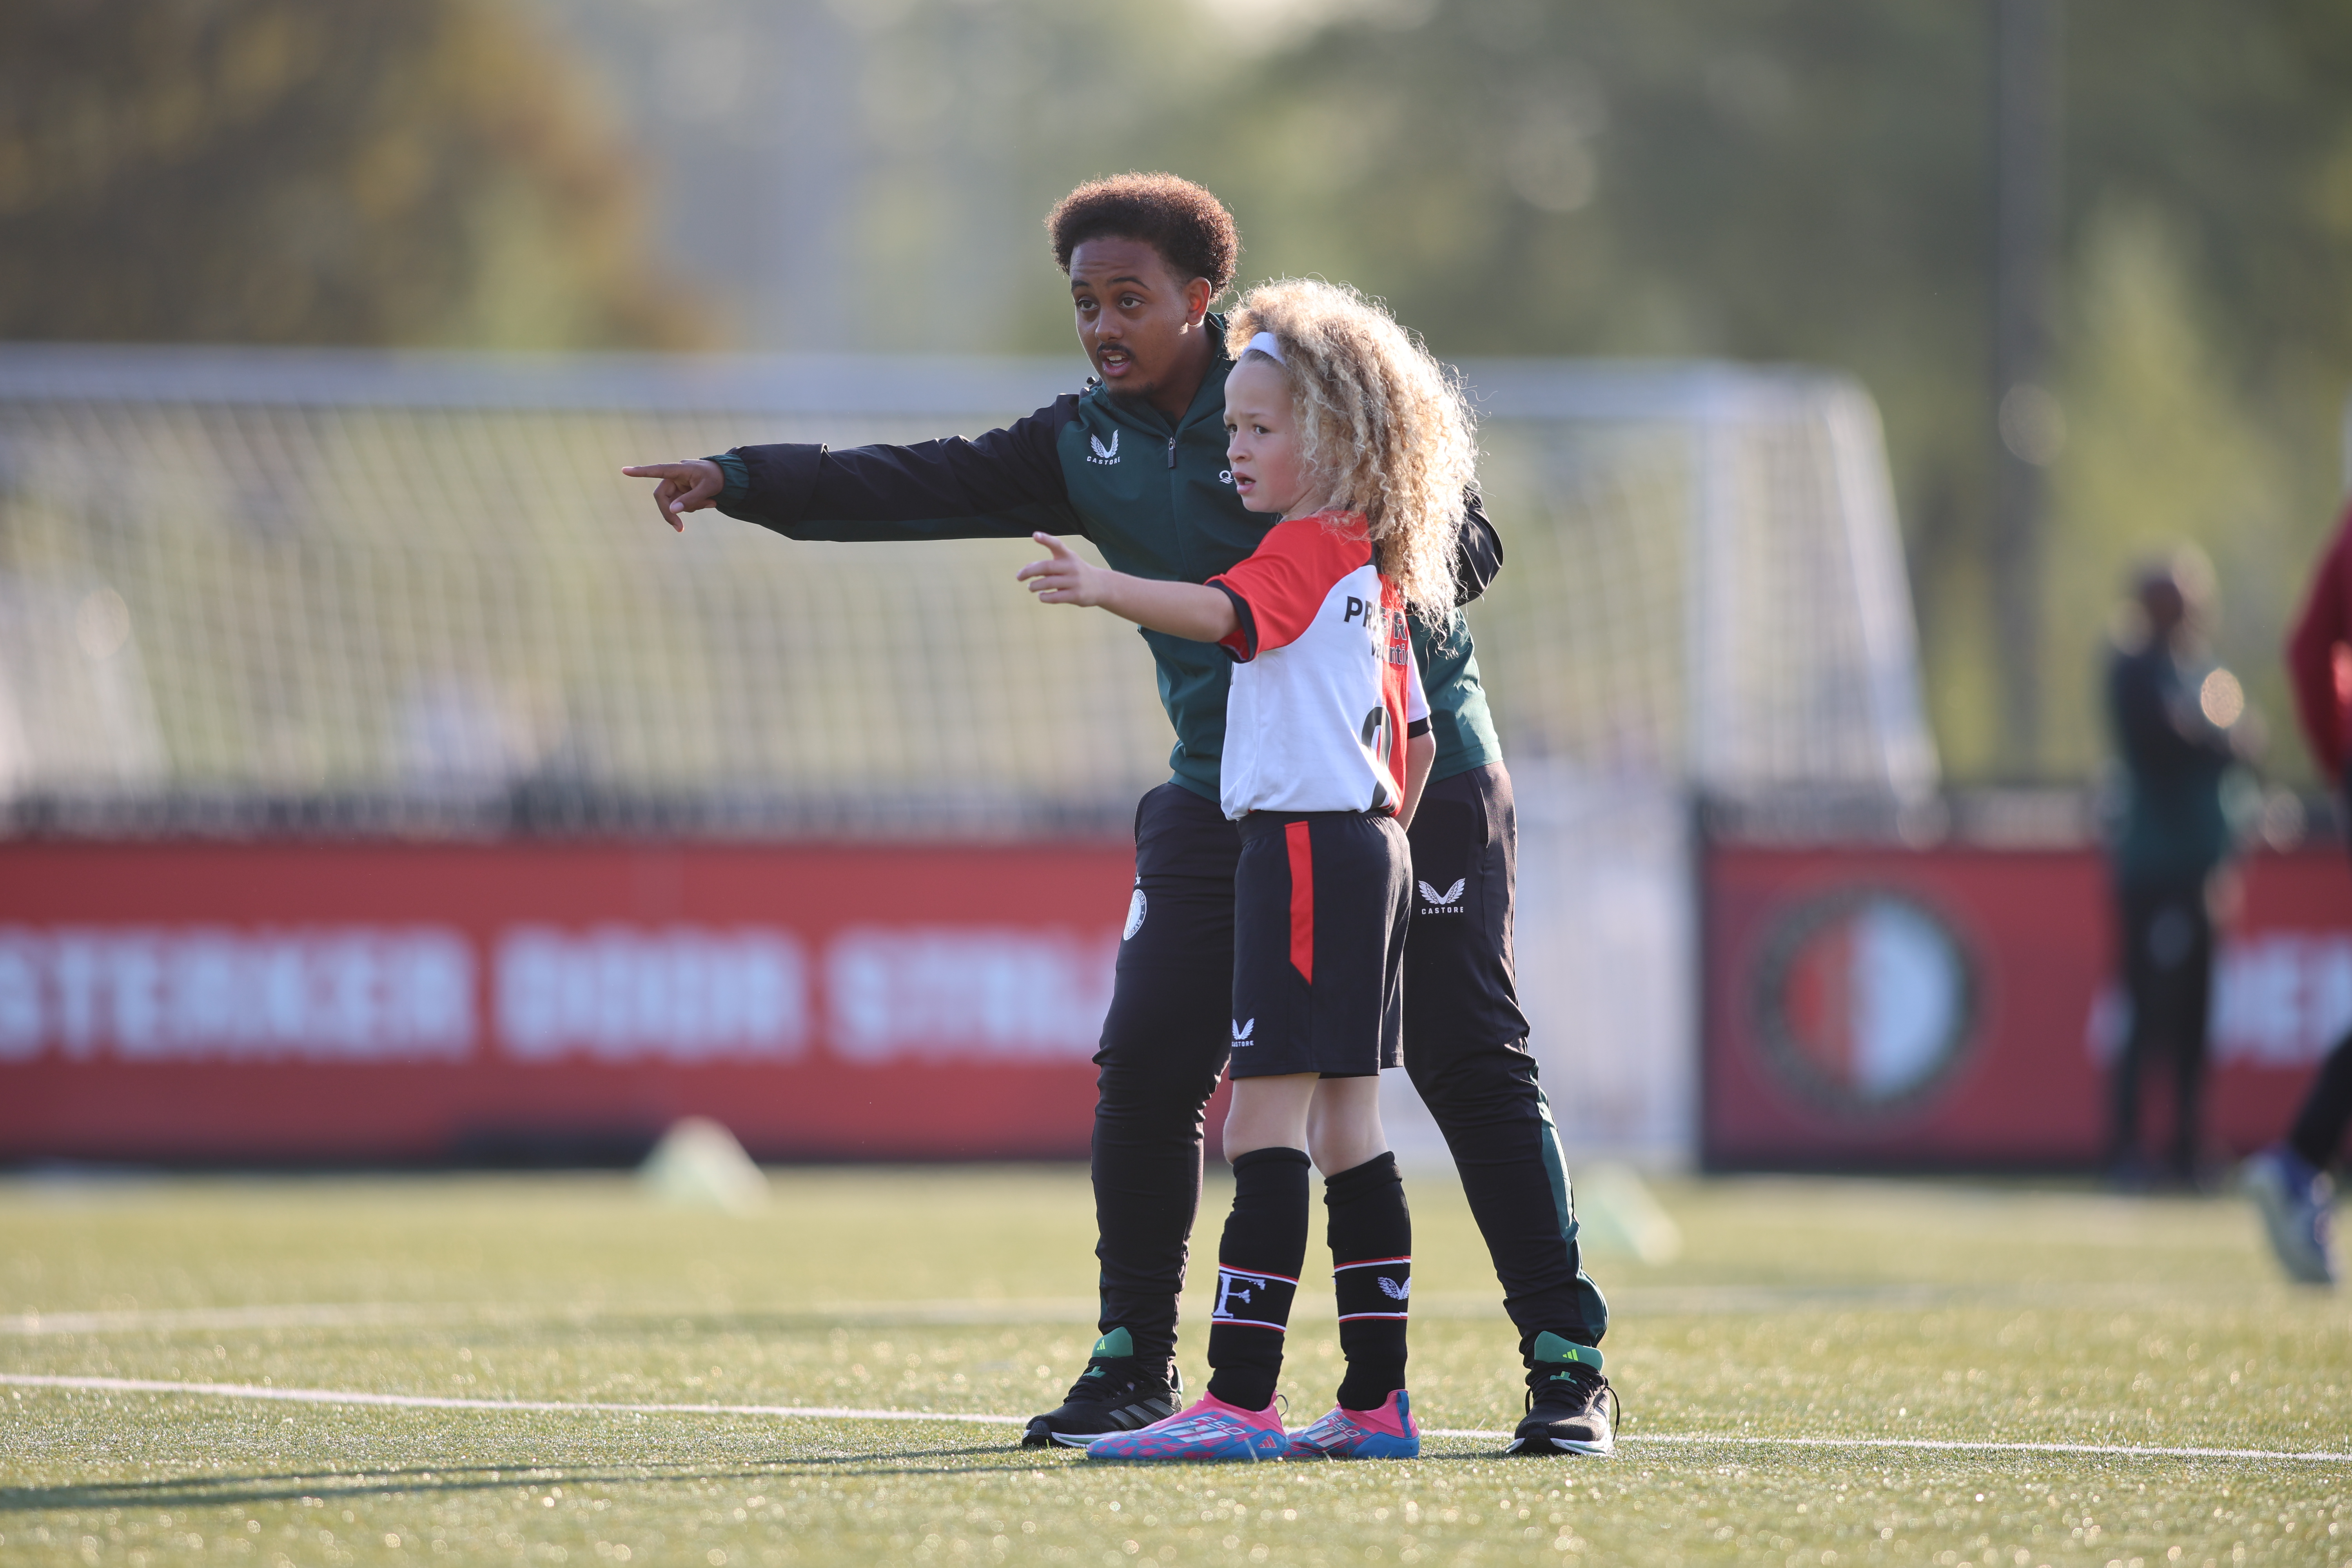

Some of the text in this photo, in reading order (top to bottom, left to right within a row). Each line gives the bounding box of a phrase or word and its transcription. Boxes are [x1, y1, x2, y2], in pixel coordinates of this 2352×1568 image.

[1087, 456, 1120, 465] CASTORE
[1421, 906, 1464, 915] CASTORE
[1193, 1416, 1247, 1435] F50
[1327, 1416, 1361, 1437] F50
